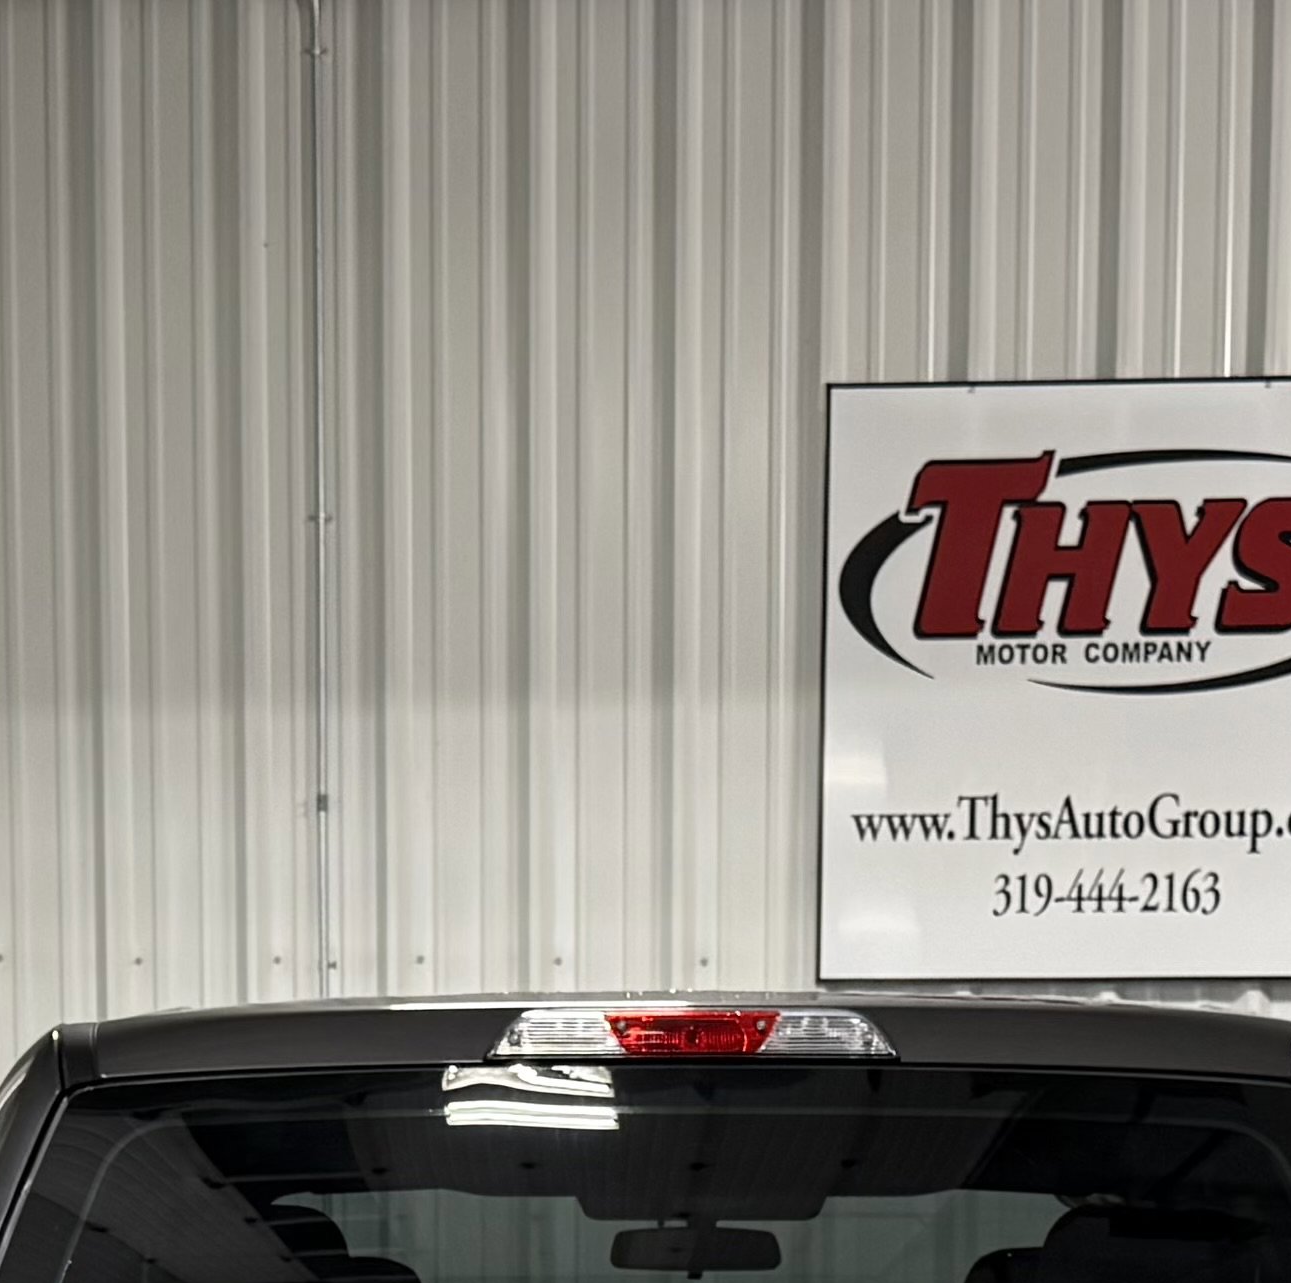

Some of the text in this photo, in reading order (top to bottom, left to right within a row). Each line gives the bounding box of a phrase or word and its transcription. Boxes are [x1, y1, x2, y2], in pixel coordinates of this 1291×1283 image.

[975, 641, 1212, 665] MOTOR COMPANY
[992, 868, 1222, 916] 319-444-2163
